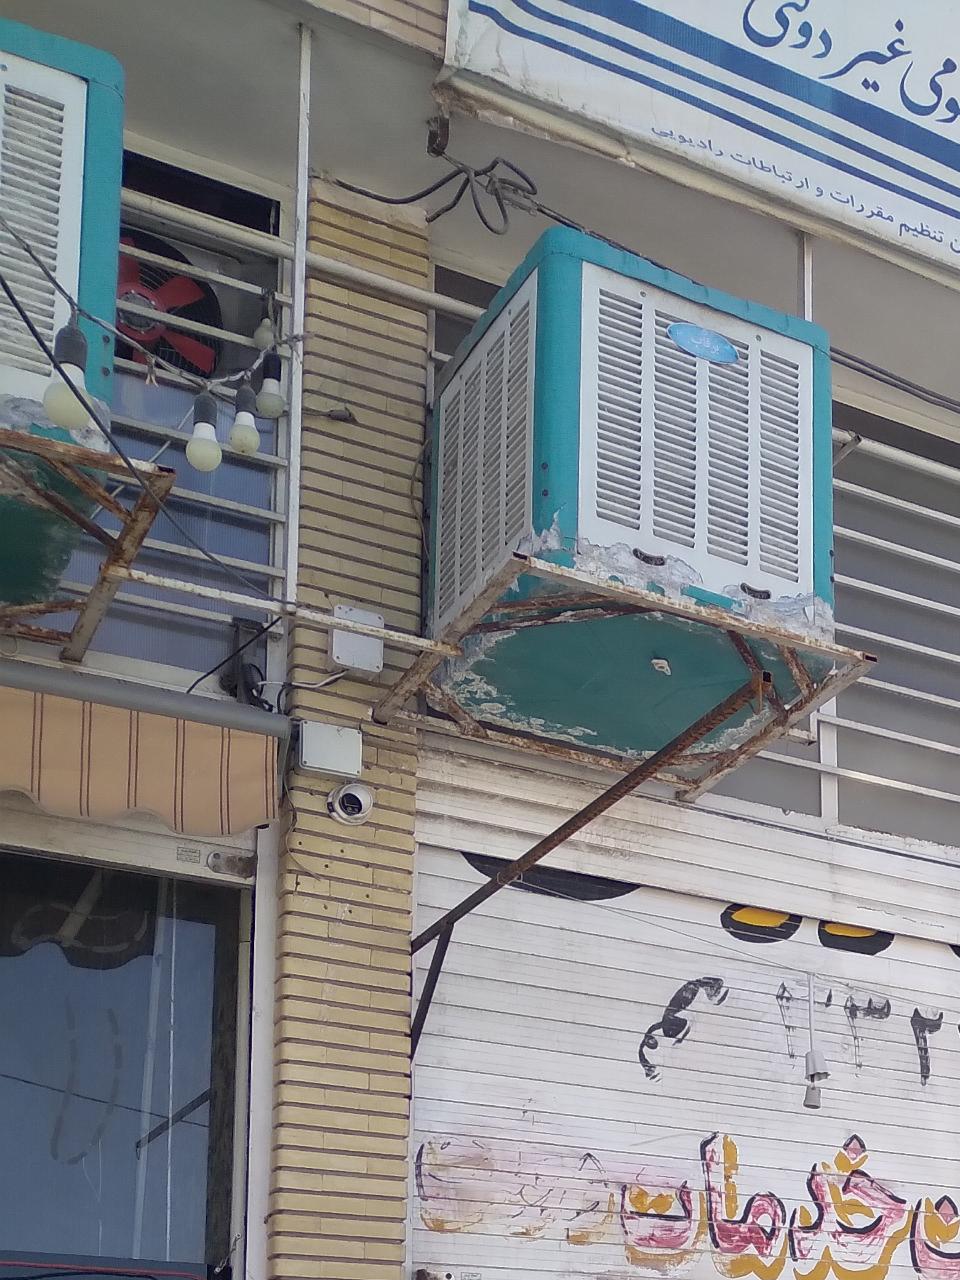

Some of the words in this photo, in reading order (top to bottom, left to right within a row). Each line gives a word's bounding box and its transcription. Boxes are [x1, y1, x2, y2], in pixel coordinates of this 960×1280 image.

[818, 18, 912, 93] غیر
[650, 126, 724, 157] رادیویی
[829, 190, 894, 222] مقررات
[898, 221, 945, 244] تنظیم
